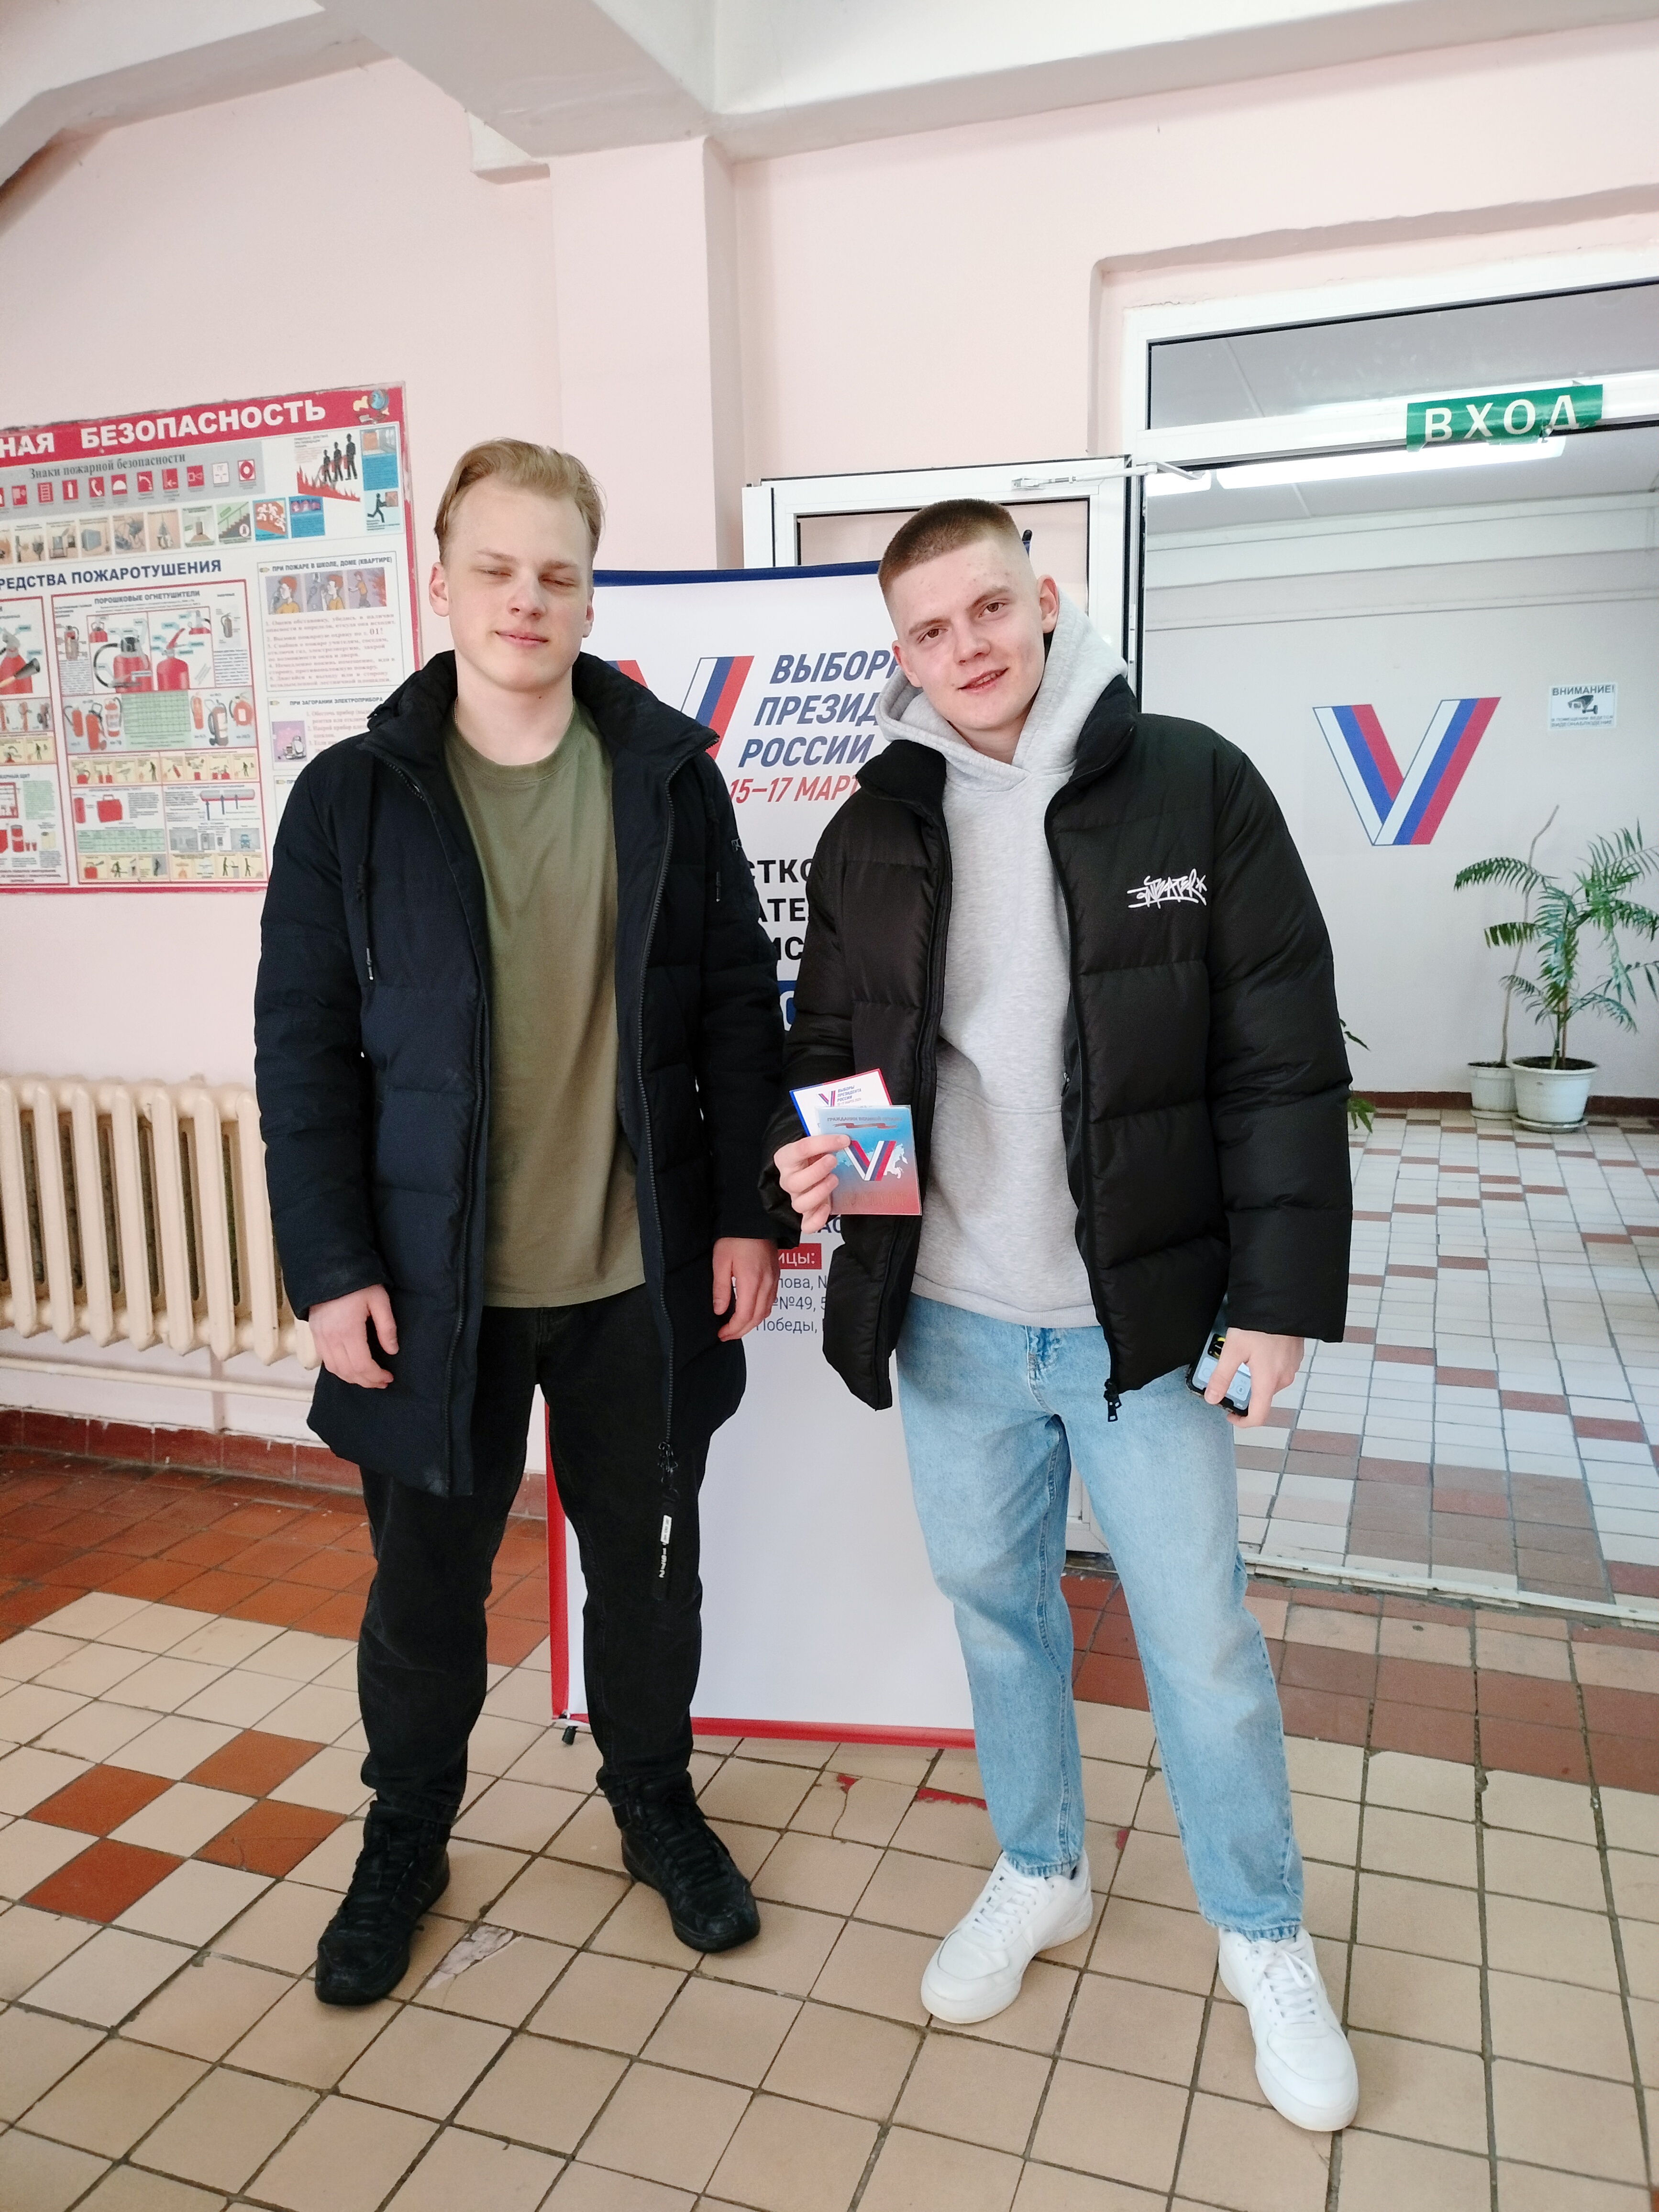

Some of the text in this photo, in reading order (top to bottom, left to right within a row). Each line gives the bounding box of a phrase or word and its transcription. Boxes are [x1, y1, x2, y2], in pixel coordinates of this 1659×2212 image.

[0, 399, 325, 458] НАЯ БЕЗОПАСНОСТЬ
[1424, 395, 1579, 443] ВХОД
[30, 453, 186, 479] Знаки пожарной безопасности
[72, 559, 221, 584] ПОЖАРОТУШЕНИЯ
[358, 556, 392, 565] (КВАРТИРЕ)
[95, 591, 200, 604] ПОРОШКОВЫЕ ОГНЕТУШИТЕЛИ
[1552, 685, 1615, 696] ВНИМАНИЕ!
[738, 734, 875, 768] РОССИИ
[837, 1088, 862, 1097] ПРЕЗИДЕНТА
